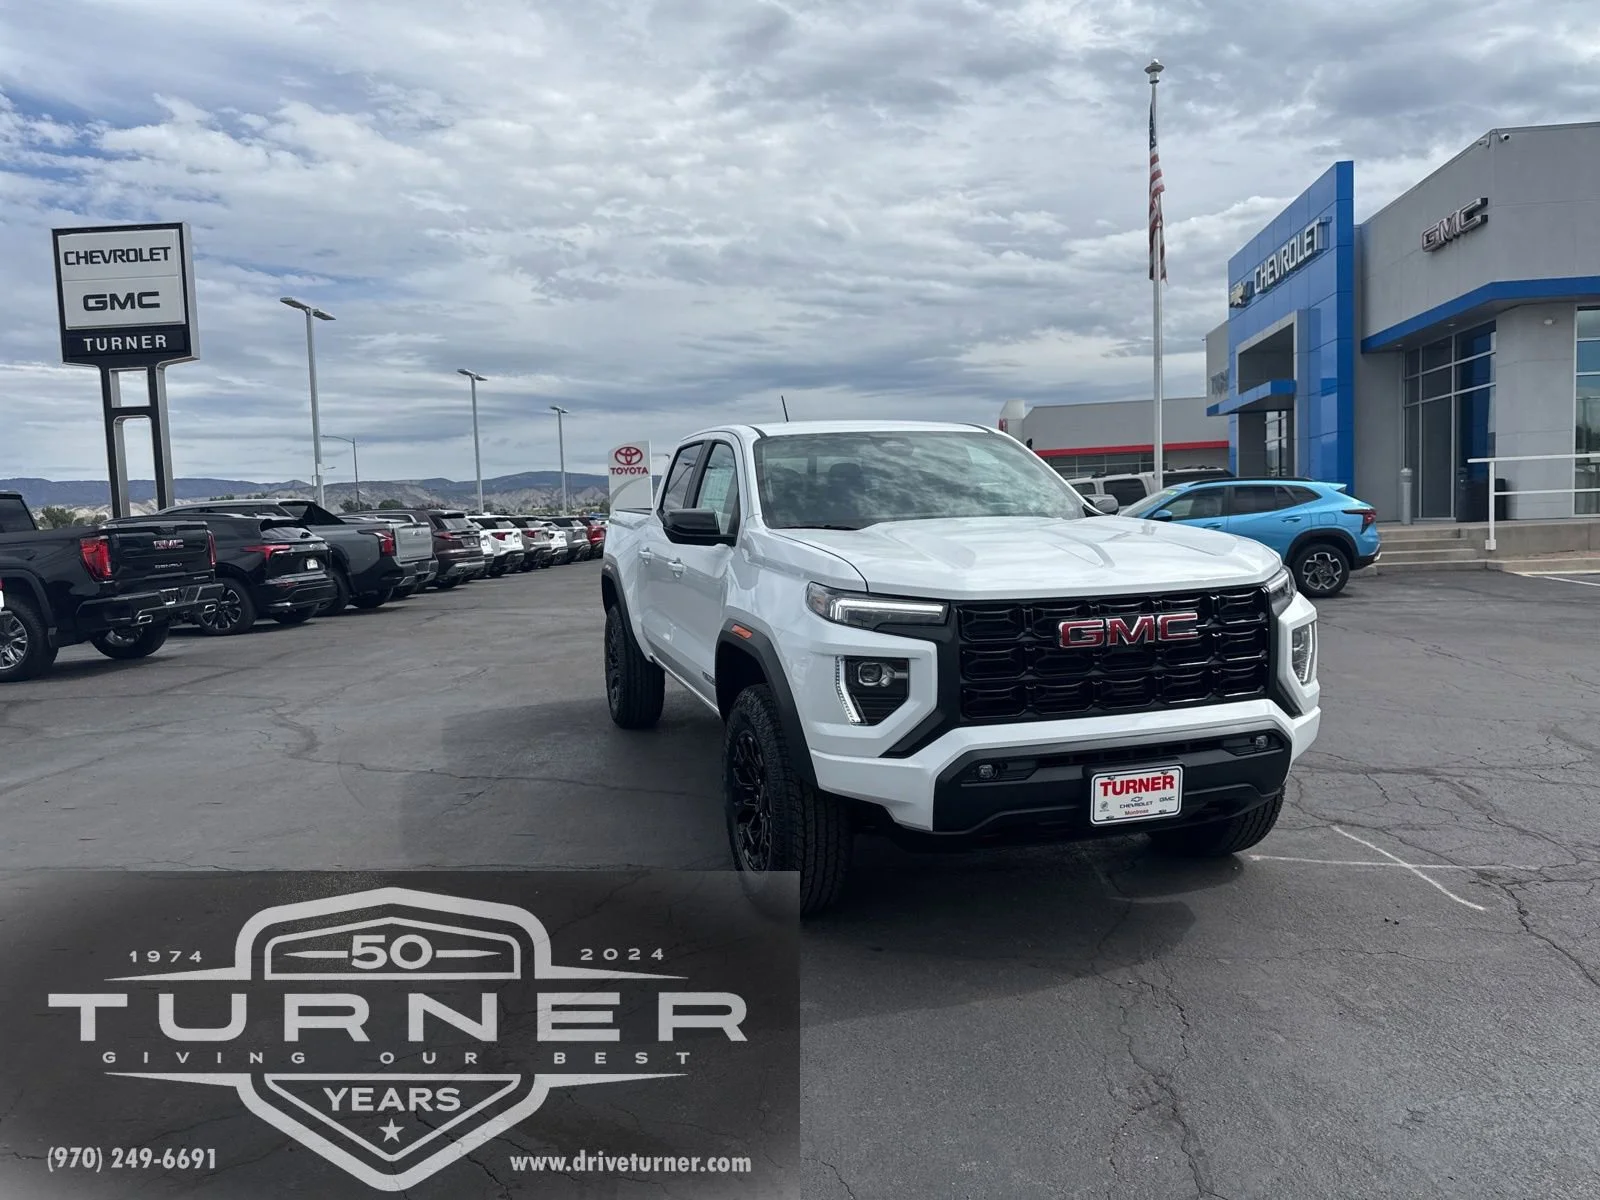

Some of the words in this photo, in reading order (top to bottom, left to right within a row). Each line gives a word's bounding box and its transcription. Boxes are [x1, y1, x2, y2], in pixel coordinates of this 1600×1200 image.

[1422, 197, 1489, 252] GMC
[64, 247, 171, 265] CHEVROLET
[1254, 216, 1333, 294] CHEVROLET
[83, 291, 160, 311] GMC
[83, 335, 167, 351] TURNER
[610, 467, 649, 475] TOYOTA
[154, 539, 184, 550] GMC
[1058, 612, 1198, 648] GMC
[1100, 775, 1175, 796] TURNER
